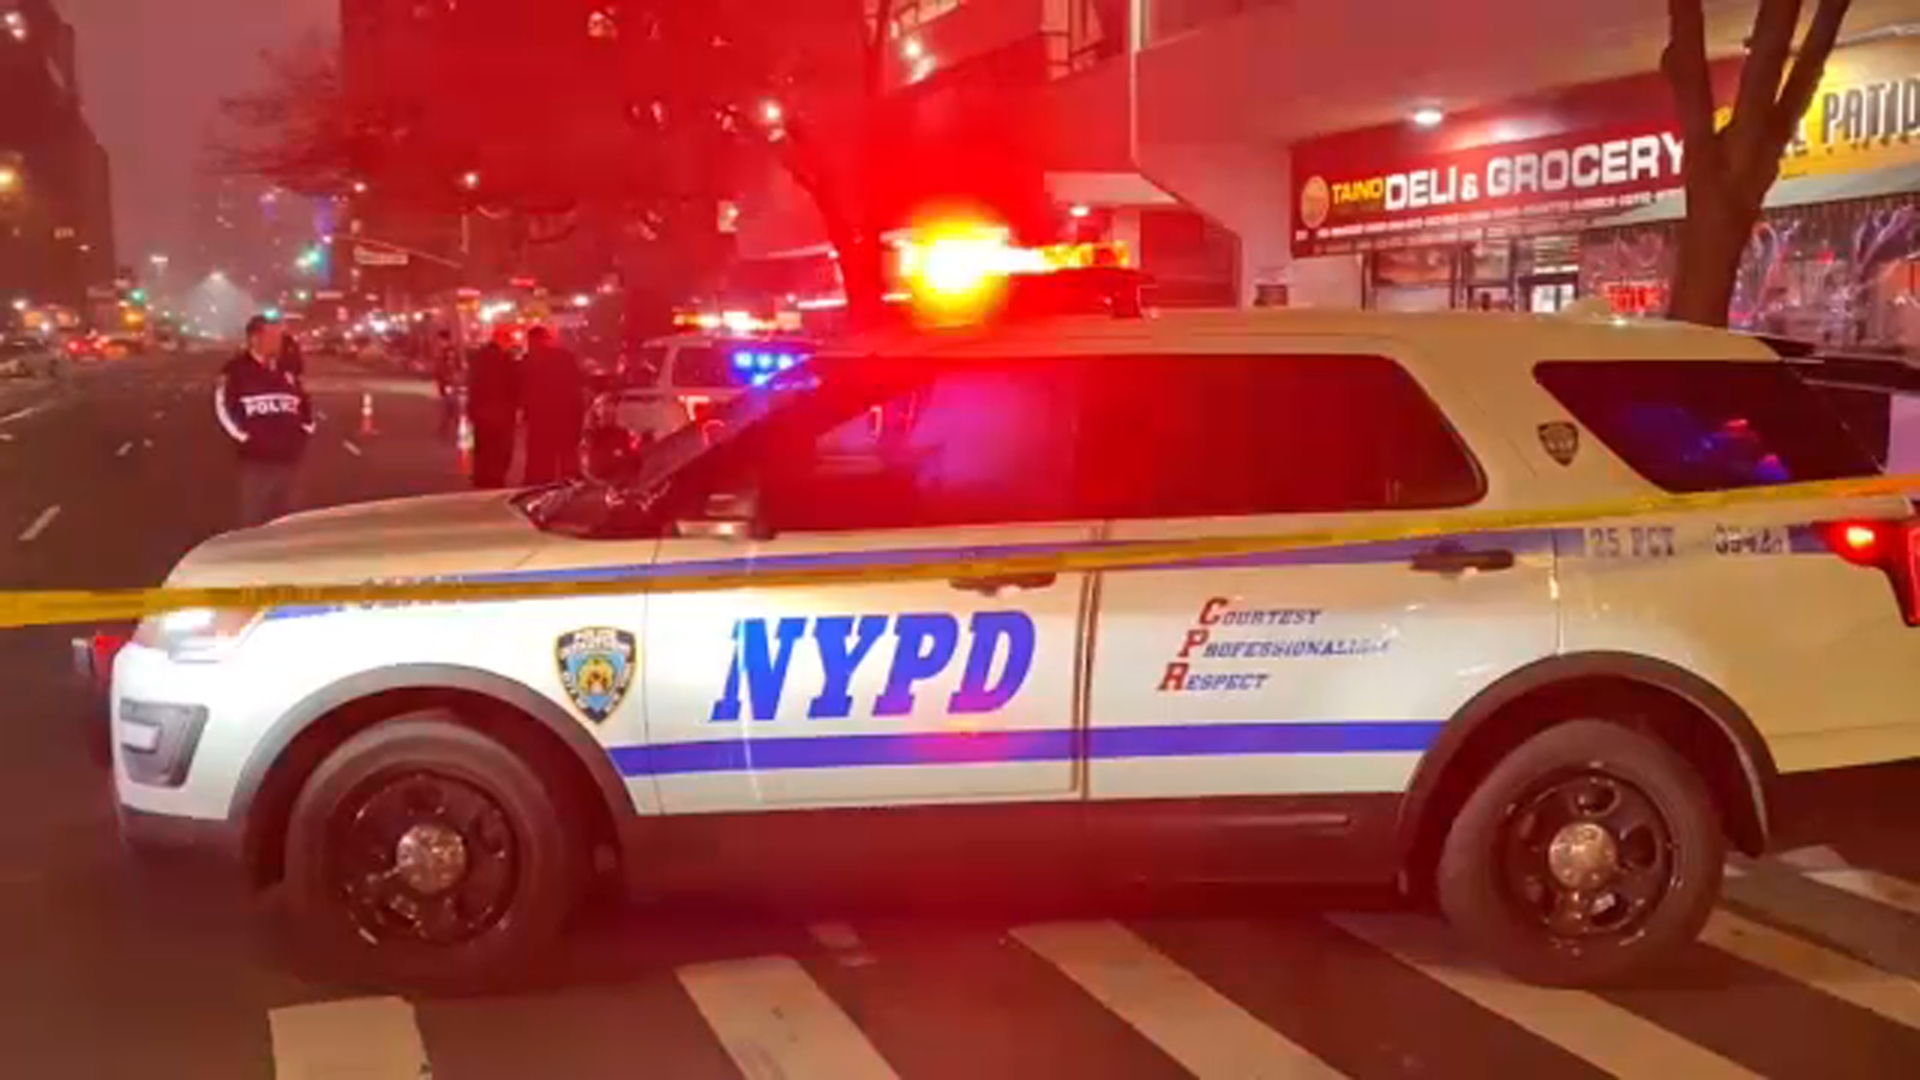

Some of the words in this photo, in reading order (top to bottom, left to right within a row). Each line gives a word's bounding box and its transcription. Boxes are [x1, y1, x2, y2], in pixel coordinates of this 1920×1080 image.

[1332, 177, 1384, 204] TAINO
[1385, 166, 1457, 211] DELI
[1461, 173, 1479, 200] &
[1487, 131, 1683, 197] GROCERY
[709, 609, 1036, 722] NYPD
